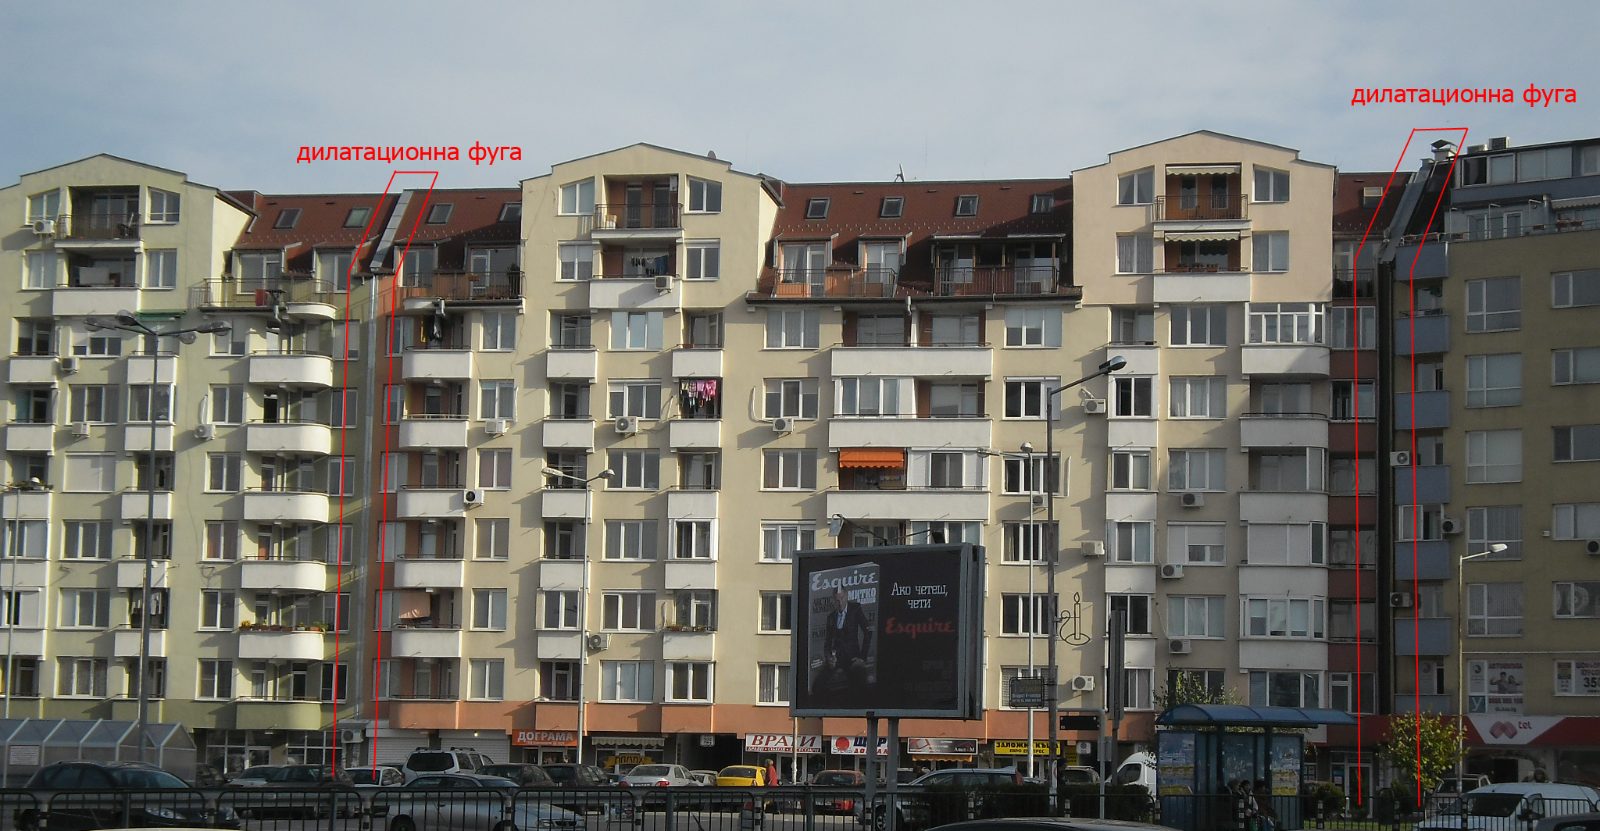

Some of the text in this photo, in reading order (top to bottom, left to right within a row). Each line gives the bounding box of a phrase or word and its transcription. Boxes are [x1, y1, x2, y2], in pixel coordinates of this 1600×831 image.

[812, 570, 878, 592] Esquire
[891, 582, 911, 596] Ако
[908, 599, 931, 609] чети
[885, 617, 954, 639] Esquire
[517, 731, 574, 742] ДОГРАМА
